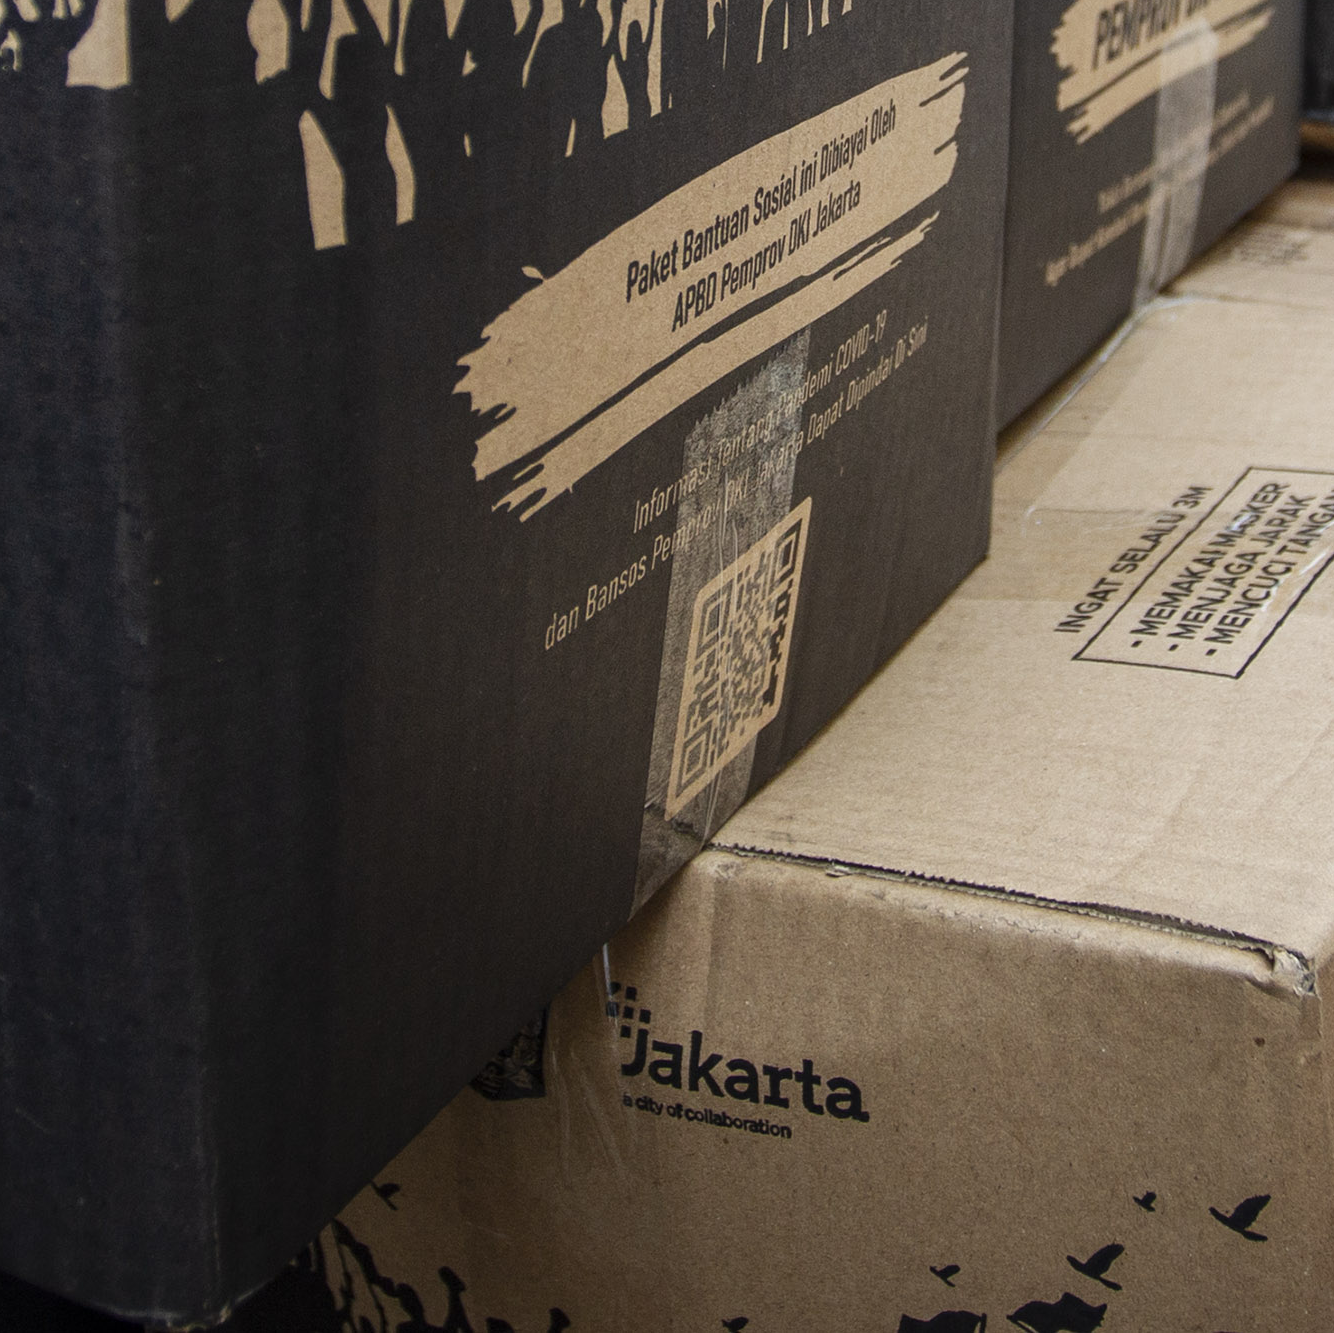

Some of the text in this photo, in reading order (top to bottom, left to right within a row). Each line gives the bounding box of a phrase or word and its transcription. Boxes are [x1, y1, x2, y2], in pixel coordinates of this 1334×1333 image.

[626, 241, 678, 302] Paket
[682, 204, 750, 271] Bantuan
[753, 167, 797, 227] Sosial
[820, 117, 868, 181] Dibiayai
[870, 99, 896, 146] Oleh
[671, 178, 861, 332] APBD Pemprov DKI Jakarta
[545, 315, 928, 651] dan Bansos Pemprov DKI Jakarta Dapat Dipindai Di Sini
[633, 310, 887, 534] Informasi Tentang Pandemi COVID-19
[1054, 485, 1214, 633] INGAT SELALU 3M
[1129, 551, 1222, 636] MEMAKAI
[1211, 481, 1291, 550] MASKER
[1167, 552, 1256, 640] MENJAGA
[1252, 494, 1317, 549] JARAK
[1204, 554, 1297, 645] MENCUCI
[635, 1096, 663, 1115] city
[667, 1103, 683, 1119] of
[685, 1108, 792, 1139] collaboration
